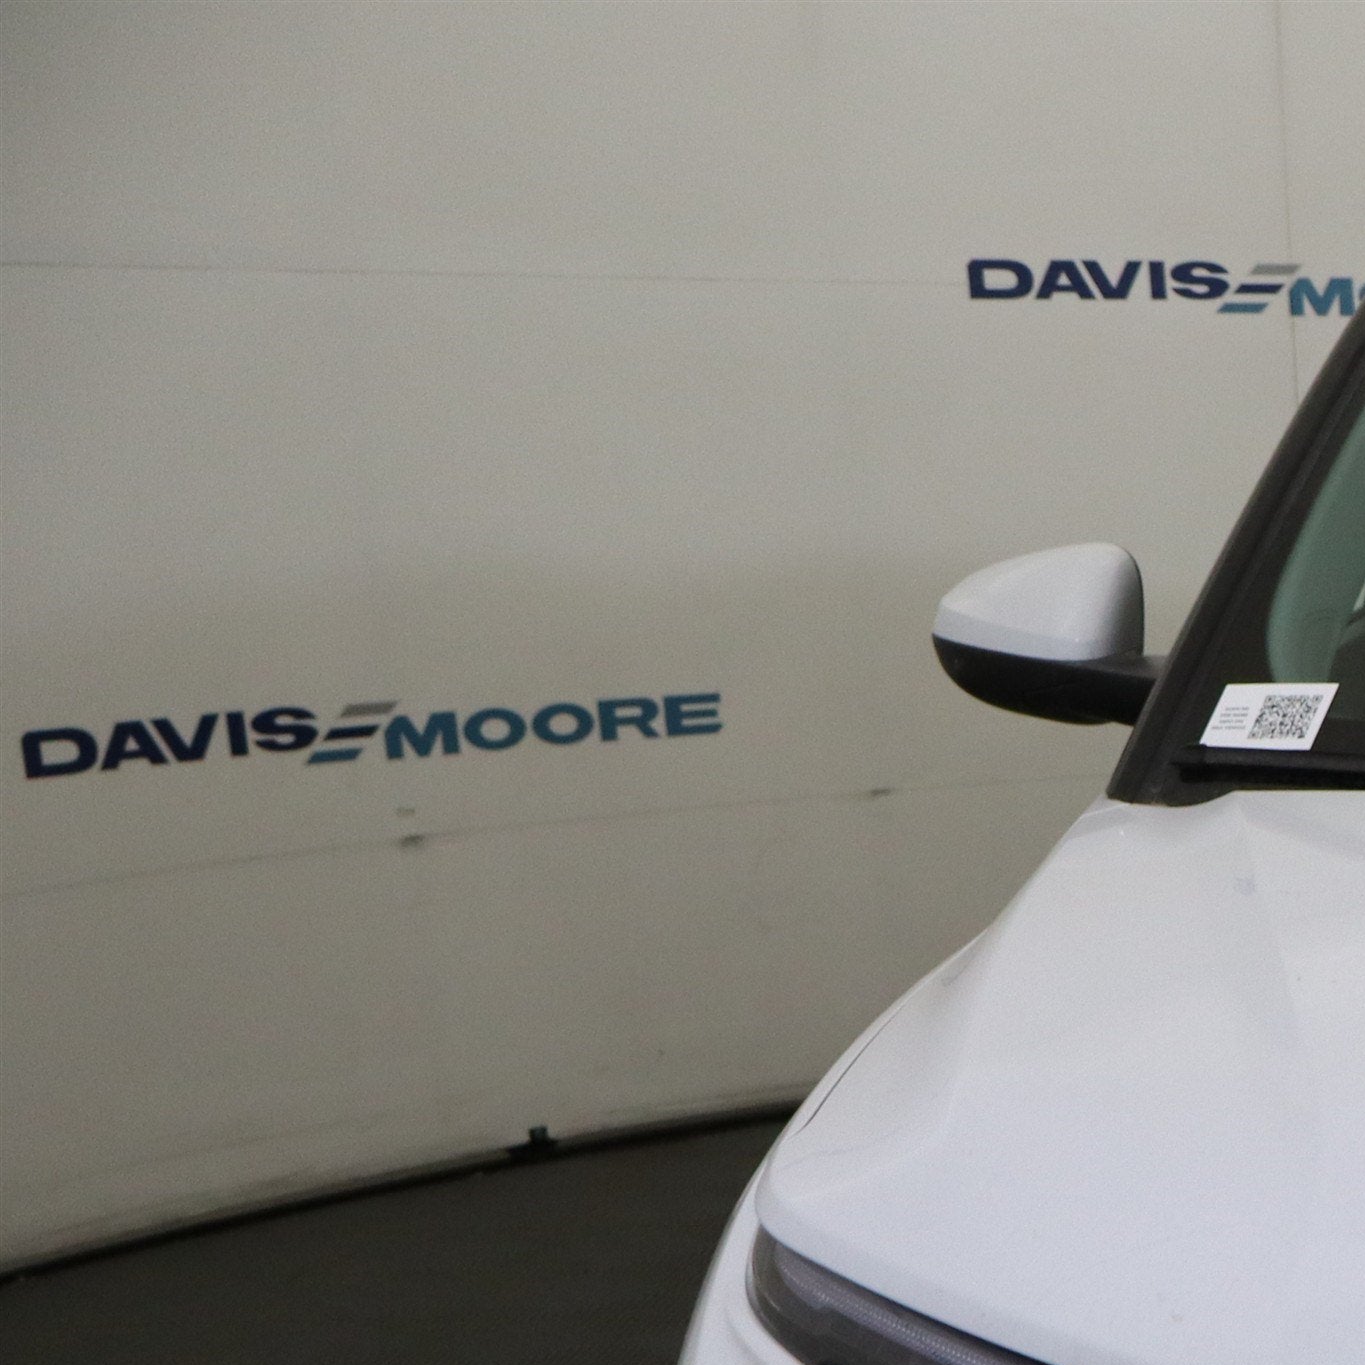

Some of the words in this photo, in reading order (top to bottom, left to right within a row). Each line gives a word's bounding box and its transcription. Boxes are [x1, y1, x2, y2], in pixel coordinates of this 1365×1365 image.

[967, 259, 1231, 300] DAVIS
[20, 706, 317, 779] DAVIS
[384, 693, 724, 761] MOORE
